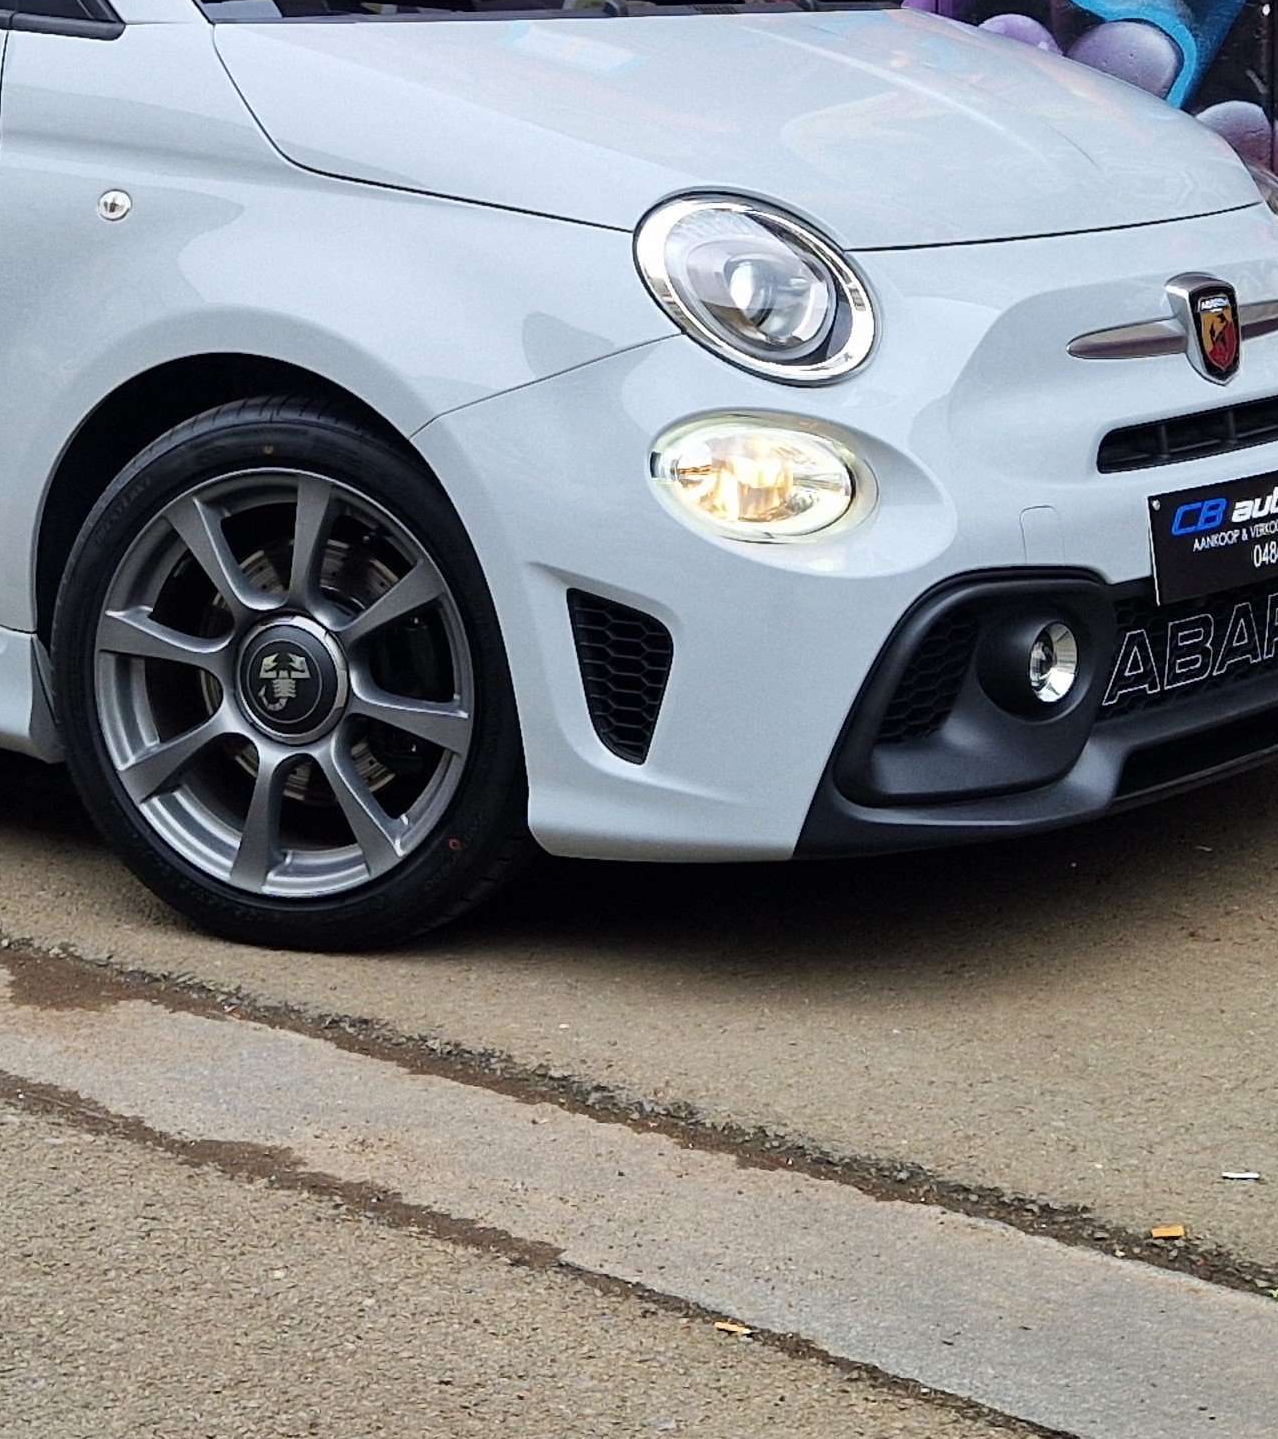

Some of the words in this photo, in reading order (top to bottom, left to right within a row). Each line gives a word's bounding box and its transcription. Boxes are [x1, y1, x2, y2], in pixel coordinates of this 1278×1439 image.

[1171, 498, 1228, 536] CB
[1192, 529, 1240, 553] AANKOOP
[1241, 527, 1249, 542] &
